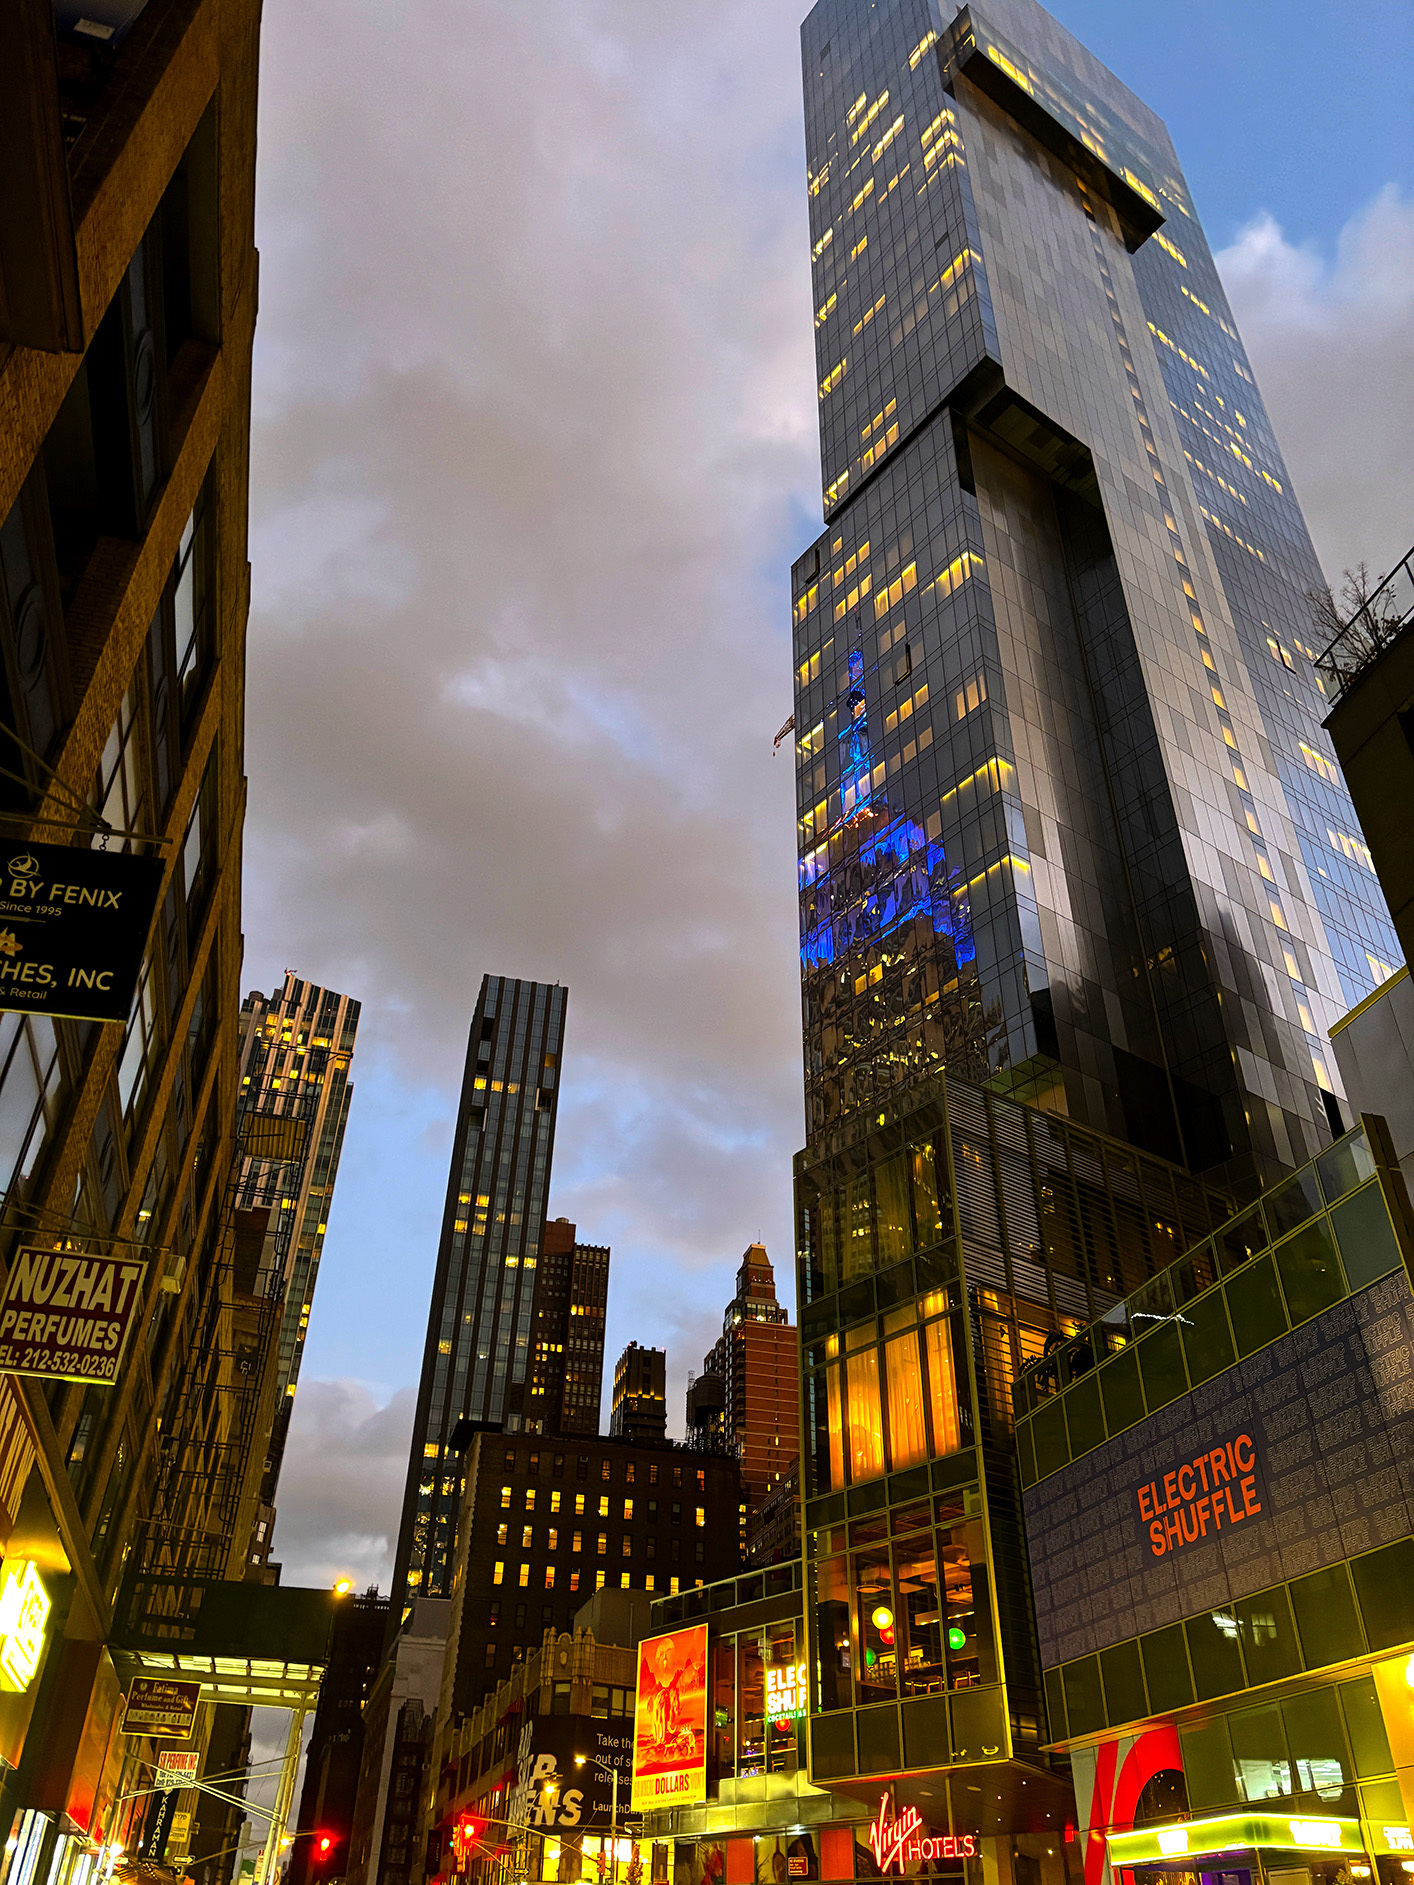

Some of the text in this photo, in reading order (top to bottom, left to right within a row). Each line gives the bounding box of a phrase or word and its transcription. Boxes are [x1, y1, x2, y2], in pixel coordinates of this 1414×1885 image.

[0, 901, 62, 917] Since 1995
[9, 879, 123, 910] BY FENIX
[0, 960, 114, 991] HES, INC
[10, 987, 47, 1000] Retail
[9, 1253, 139, 1314] NUZHAT
[0, 1309, 121, 1351] PERFUMES
[21, 1347, 116, 1378] 212-532-0236
[1356, 1345, 1410, 1383] ELECTRIC
[1361, 1359, 1412, 1394] SHUFFLE
[1137, 1434, 1255, 1522] ELECTRIC
[1149, 1474, 1261, 1556] SHUFFLE
[767, 1664, 806, 1692] ELEC
[767, 1687, 807, 1714] SHUF
[596, 1733, 619, 1748] Take
[595, 1754, 612, 1765] out
[613, 1754, 624, 1767] of
[594, 1771, 633, 1785] releses
[655, 1773, 690, 1796] DOLLARS
[148, 1796, 169, 1857] KAHRAMAN
[869, 1791, 923, 1875] Virgin
[908, 1834, 975, 1861] HOTELS
